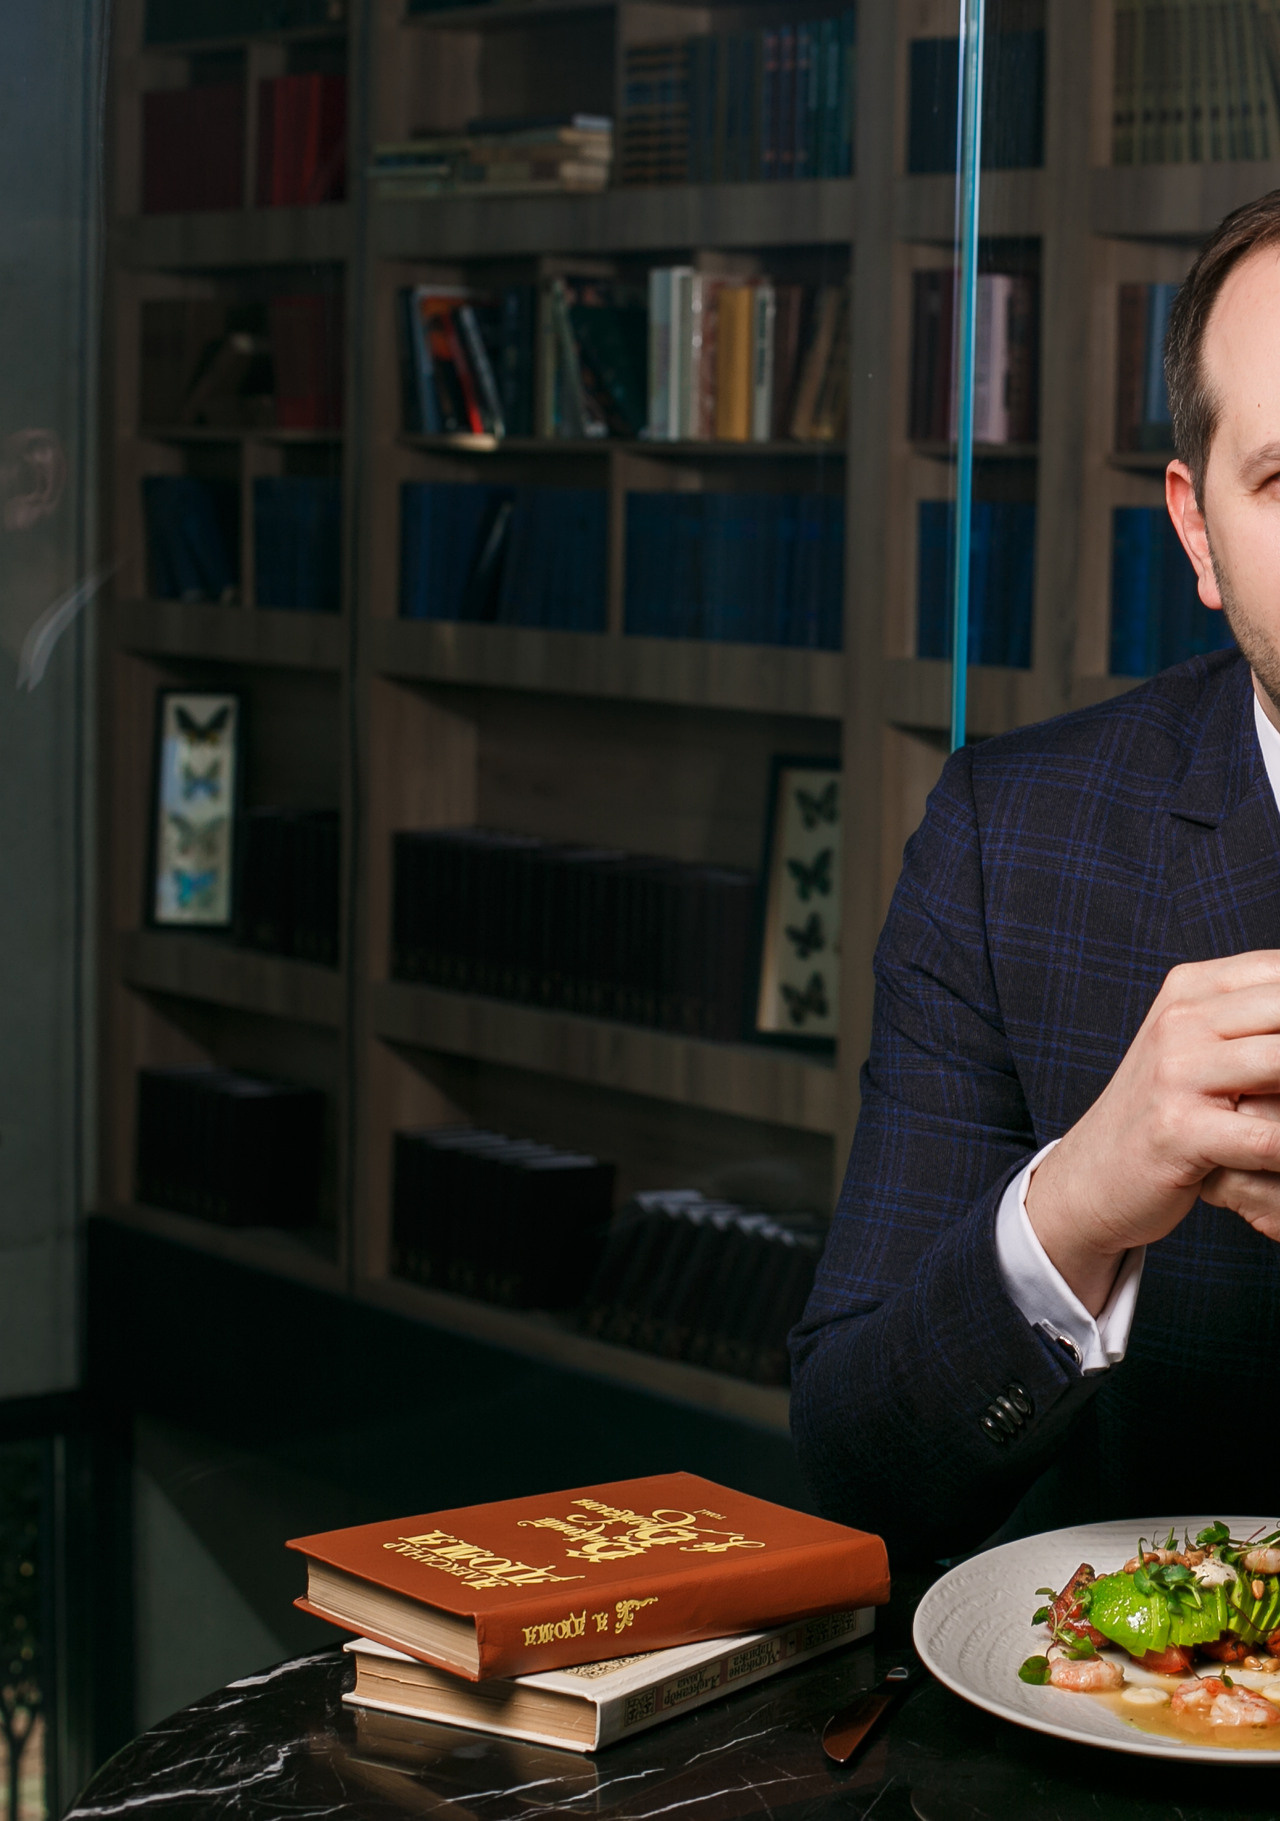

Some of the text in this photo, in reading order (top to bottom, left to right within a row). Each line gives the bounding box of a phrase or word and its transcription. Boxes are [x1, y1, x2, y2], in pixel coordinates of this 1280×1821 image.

[383, 1542, 509, 1590] АЛЕКСАНДР
[398, 1530, 586, 1586] ДЮМА
[521, 1609, 587, 1646] ДЮМА
[733, 1642, 774, 1666] Парижа
[664, 1674, 720, 1705] Александр
[677, 1666, 706, 1688] Дюма
